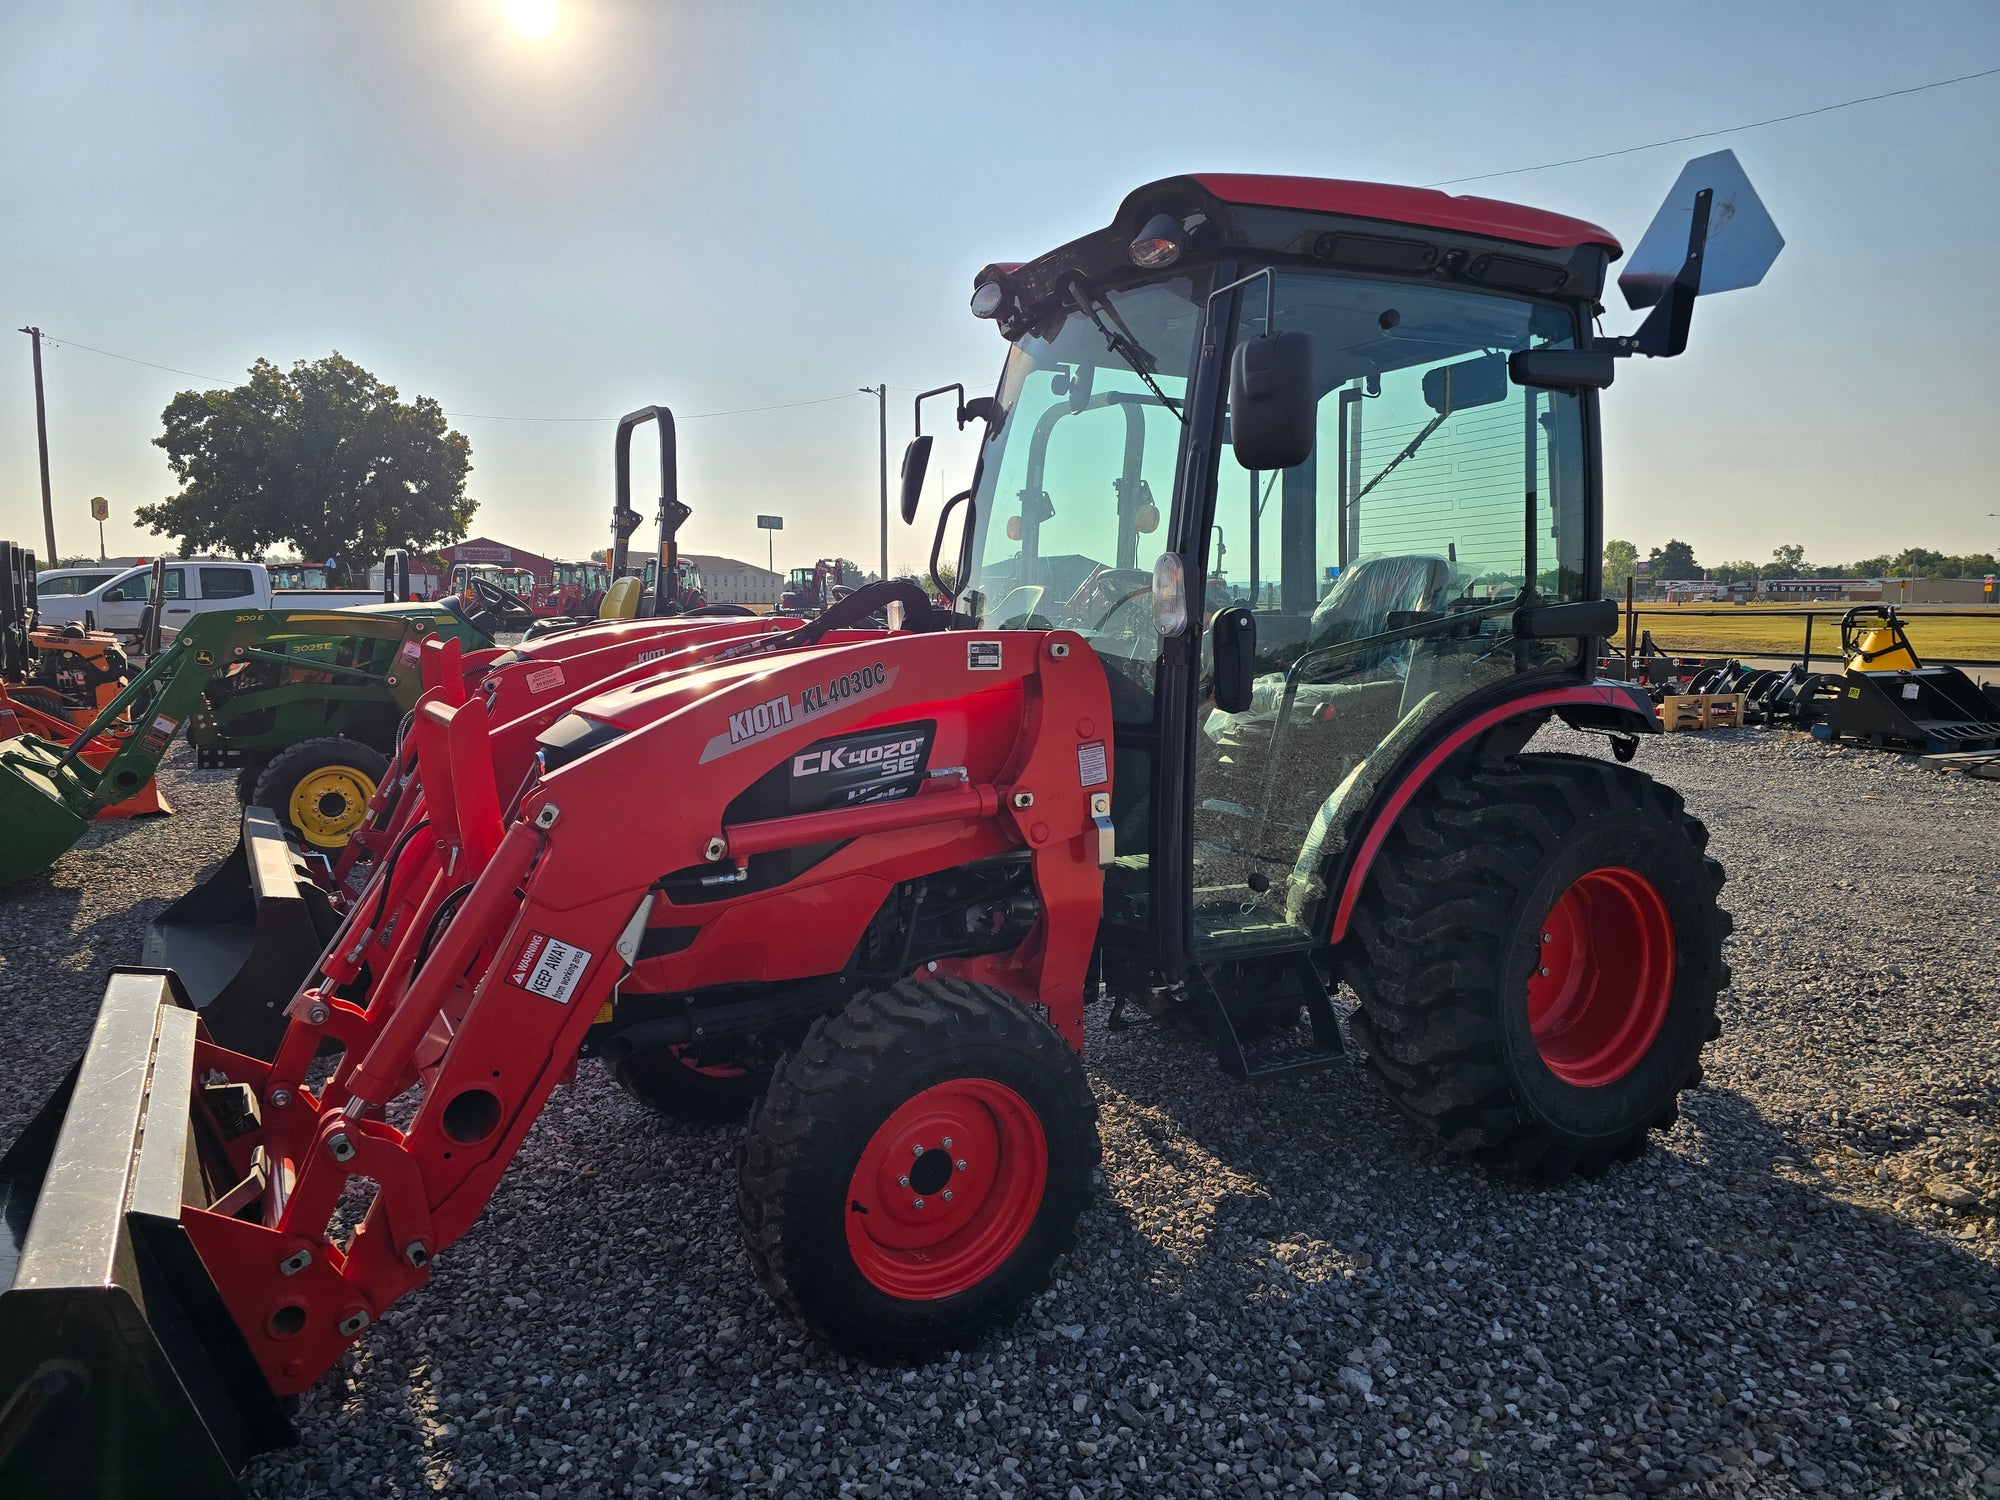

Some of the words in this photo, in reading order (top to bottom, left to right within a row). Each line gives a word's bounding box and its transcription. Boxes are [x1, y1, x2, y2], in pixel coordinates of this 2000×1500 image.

[293, 642, 334, 654] 3025E
[728, 694, 792, 744] KIOTI
[801, 662, 886, 716] KL4030C
[881, 755, 915, 776] SE
[516, 934, 543, 971] WARNING
[531, 969, 553, 994] KEEP
[544, 942, 568, 971] AWAY
[552, 985, 566, 999] from
[560, 963, 579, 986] working
[572, 951, 584, 965] area
